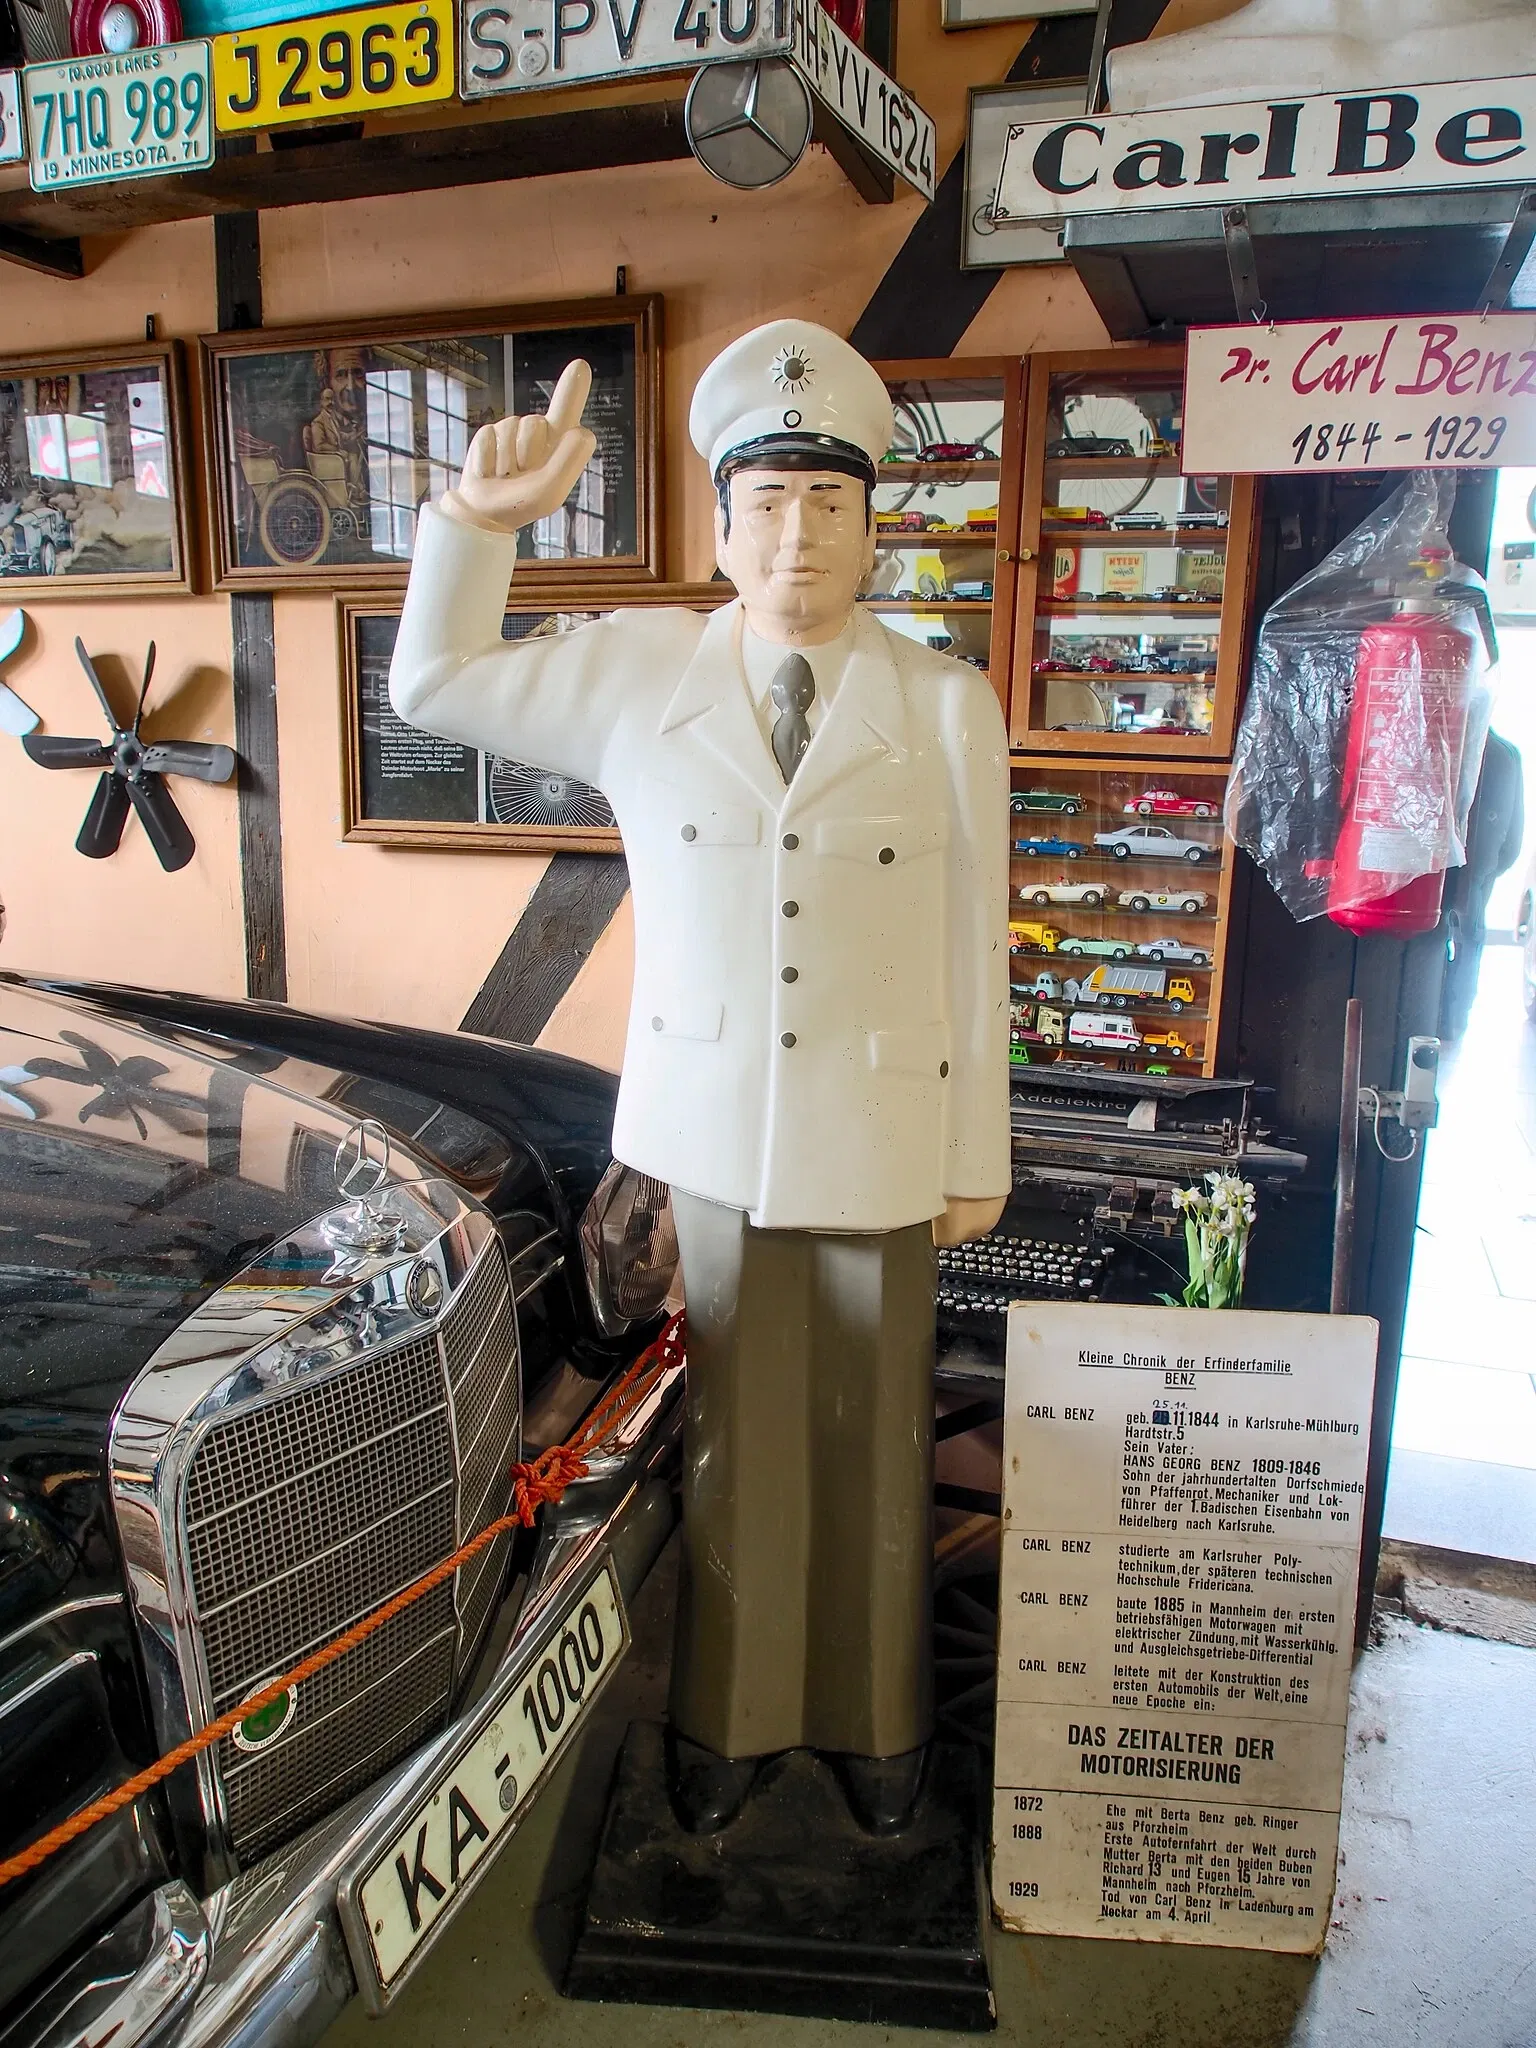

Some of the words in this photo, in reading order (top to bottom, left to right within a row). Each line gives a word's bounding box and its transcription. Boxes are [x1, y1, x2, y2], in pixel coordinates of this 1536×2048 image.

[115, 52, 161, 75] LAKES
[228, 46, 259, 113] J
[277, 17, 440, 109] 2963
[33, 86, 111, 158] 7HQ
[125, 72, 204, 146] 989
[879, 78, 932, 189] 1624
[1032, 102, 1306, 195] Carl
[1327, 92, 1528, 178] Be
[44, 162, 59, 179] 19
[71, 145, 168, 176] MINNESOTA
[182, 140, 199, 160] 71
[1220, 347, 1270, 387] Dr.
[1292, 325, 1398, 396] Carl
[1395, 323, 1536, 396] Benz
[1291, 421, 1382, 465] 1844
[1424, 415, 1507, 461] 1929
[1079, 1350, 1113, 1364] Kleine
[1124, 1353, 1166, 1367] Chronik
[1177, 1356, 1195, 1368] der
[1205, 1357, 1290, 1372] Erfinderfamilie
[1165, 1372, 1195, 1385] BENZ
[1027, 1405, 1056, 1419] CARL
[1065, 1408, 1094, 1421] BENZ
[1126, 1412, 1149, 1425] geb.
[1228, 1416, 1238, 1428] in
[1246, 1416, 1358, 1435] Karlsruhe-Mühlburg
[1123, 1440, 1148, 1453] Sein
[1124, 1454, 1154, 1469] HANS
[1161, 1456, 1201, 1470] GEORG
[1211, 1459, 1240, 1472] BENZ
[1252, 1459, 1320, 1476] 1809-1846
[1123, 1468, 1150, 1483] Sohn
[1157, 1470, 1176, 1484] der
[1181, 1472, 1276, 1488] jahrhundertalten
[1287, 1476, 1364, 1494] Dorfschmiede
[1122, 1484, 1140, 1497] von
[1289, 1492, 1309, 1504] und
[1319, 1494, 1342, 1506] Lok-
[1121, 1498, 1156, 1514] führer
[1164, 1500, 1184, 1512] der
[1265, 1504, 1322, 1520] Eisenbahn
[1331, 1512, 1349, 1521] von
[1119, 1514, 1178, 1530] Heidelberg
[1186, 1518, 1211, 1530] nach
[1218, 1518, 1275, 1534] Karlsruhe.
[1023, 1538, 1051, 1551] CARL
[1062, 1540, 1091, 1553] BENZ
[1119, 1544, 1169, 1559] studierte
[1179, 1550, 1194, 1560] am
[1203, 1548, 1262, 1564] Karlsruher
[1274, 1553, 1302, 1568] Poly-
[1117, 1572, 1180, 1588] Hochschule
[1189, 1577, 1253, 1593] Fridericana.
[1208, 1565, 1256, 1579] späteren
[1265, 1568, 1332, 1585] technischen
[1020, 1592, 1049, 1604] CARL
[1059, 1593, 1088, 1606] BENZ
[1117, 1596, 1146, 1611] baute
[1154, 1596, 1184, 1612] 1885
[1192, 1601, 1202, 1613] in
[1210, 1602, 1266, 1618] Mannheim
[1273, 1607, 1293, 1620] der
[1299, 1610, 1334, 1623] ersten
[1116, 1611, 1202, 1629] betriebsfähigen
[1210, 1616, 1276, 1634] Motorwagen
[1284, 1622, 1303, 1635] mit
[1116, 1626, 1182, 1641] elektrischer
[1265, 1635, 1338, 1654] Wasserkühlg.
[1115, 1641, 1134, 1654] und
[1140, 1642, 1313, 1666] Ausgleichsgetriebe-Differential
[1019, 1659, 1047, 1672] CARL
[1058, 1661, 1086, 1674] BENZ
[1114, 1664, 1149, 1679] leitete
[1158, 1667, 1176, 1680] mit
[1185, 1668, 1204, 1681] der
[1210, 1670, 1281, 1688] Konstruktion
[1290, 1676, 1309, 1689] des
[1113, 1679, 1148, 1692] ersten
[1158, 1681, 1220, 1696] Automobils
[1228, 1686, 1246, 1699] der
[1113, 1696, 1138, 1706] neue
[1146, 1694, 1185, 1709] Epoche
[1068, 1724, 1106, 1747] DAS
[1117, 1728, 1222, 1756] ZEITALTER
[1236, 1736, 1274, 1760] DER
[1081, 1753, 1240, 1784] MOTORISIERUNG
[1014, 1796, 1042, 1811] 1872
[1106, 1804, 1126, 1817] Ehe
[1136, 1806, 1153, 1819] mit
[1160, 1807, 1190, 1821] Berta
[1199, 1810, 1224, 1825] Benz
[1234, 1814, 1256, 1827] geb.
[1263, 1815, 1298, 1832] Ringer
[1106, 1820, 1124, 1832] aus
[1133, 1819, 1188, 1837] Pforzheim
[1012, 1824, 1042, 1840] 1888
[1104, 1832, 1133, 1848] Erste
[1142, 1834, 1217, 1853] Autofernfahrt
[1226, 1841, 1244, 1854] der
[1251, 1842, 1277, 1858] Welt
[1286, 1846, 1316, 1860] durch
[1103, 1846, 1140, 1864] Mutter
[1146, 1849, 1179, 1865] Berta
[1186, 1851, 1204, 1866] mit
[1210, 1854, 1232, 1868] den
[1236, 1856, 1272, 1873] beiden
[1279, 1858, 1312, 1874] Buben
[1103, 1860, 1143, 1878] Richard
[1146, 1860, 1162, 1879] 13
[1172, 1866, 1193, 1879] und
[1195, 1867, 1232, 1884] Eugen
[1236, 1867, 1252, 1884] 15
[1256, 1872, 1285, 1886] Jahre
[1292, 1877, 1310, 1888] von
[1103, 1875, 1156, 1892] Mannheim
[1166, 1880, 1192, 1894] nach
[1009, 1881, 1038, 1897] 1929
[1102, 1891, 1120, 1904] Tod
[1129, 1894, 1147, 1904] von
[1153, 1892, 1176, 1908] Carl
[1184, 1894, 1211, 1909] Benz
[1220, 1898, 1229, 1910] in
[1239, 1898, 1294, 1916] Ladenburg
[1298, 1906, 1314, 1916] am
[1146, 1908, 1161, 1920] am
[1168, 1906, 1182, 1921] 4.
[1185, 1910, 1211, 1924] April
